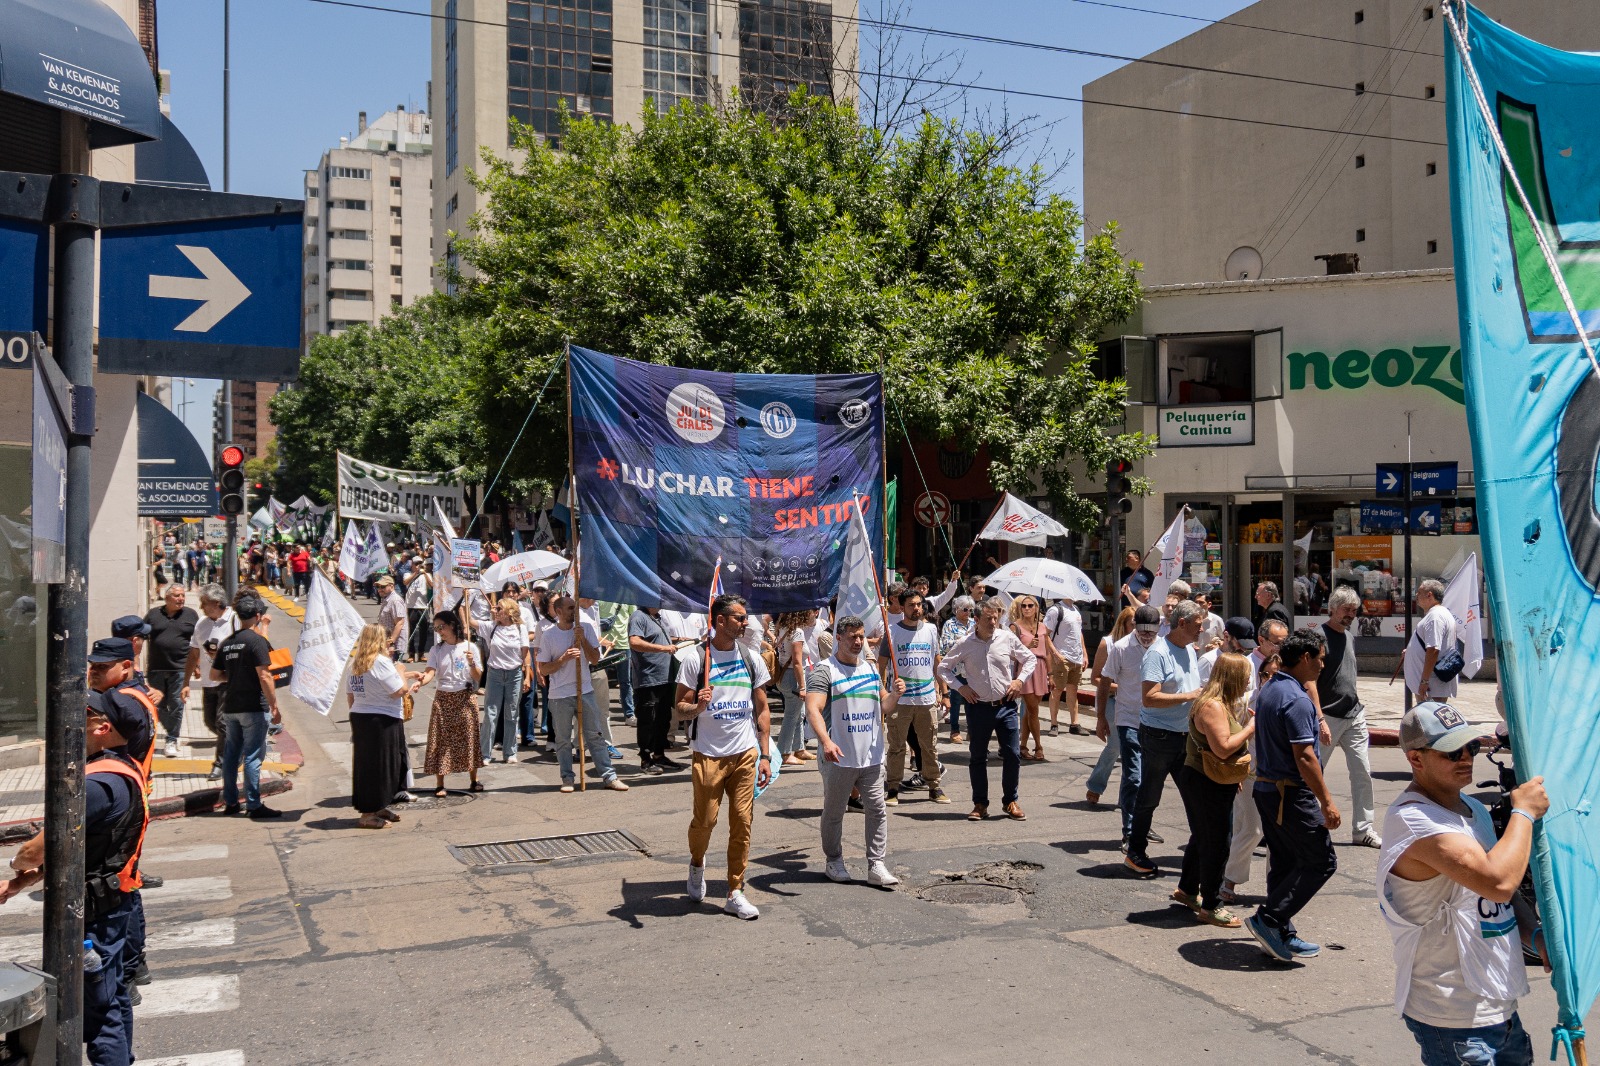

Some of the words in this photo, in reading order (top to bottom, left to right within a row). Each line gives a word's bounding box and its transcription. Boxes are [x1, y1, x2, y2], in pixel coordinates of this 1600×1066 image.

[42, 60, 64, 76] VAN
[65, 68, 121, 96] KEMENADE
[49, 77, 59, 91] &
[61, 83, 120, 110] ASOCIADOS
[48, 98, 68, 108] ESTUDIO
[0, 336, 29, 363] 0
[1165, 410, 1246, 425] Peluquería
[1179, 424, 1232, 436] Canina
[596, 457, 736, 498] #LUCHAR
[1413, 472, 1440, 480] Belgrano
[137, 481, 153, 491] AN
[155, 481, 209, 491] KEMENADE
[137, 493, 147, 503] &
[148, 493, 207, 503] ASOCIADOS
[405, 492, 460, 517] CAPITAL
[1362, 508, 1370, 516] 27
[1371, 508, 1379, 516] de
[1379, 508, 1393, 517] Abril
[706, 701, 716, 711] LA
[841, 712, 851, 721] LA
[847, 725, 857, 733] EN
